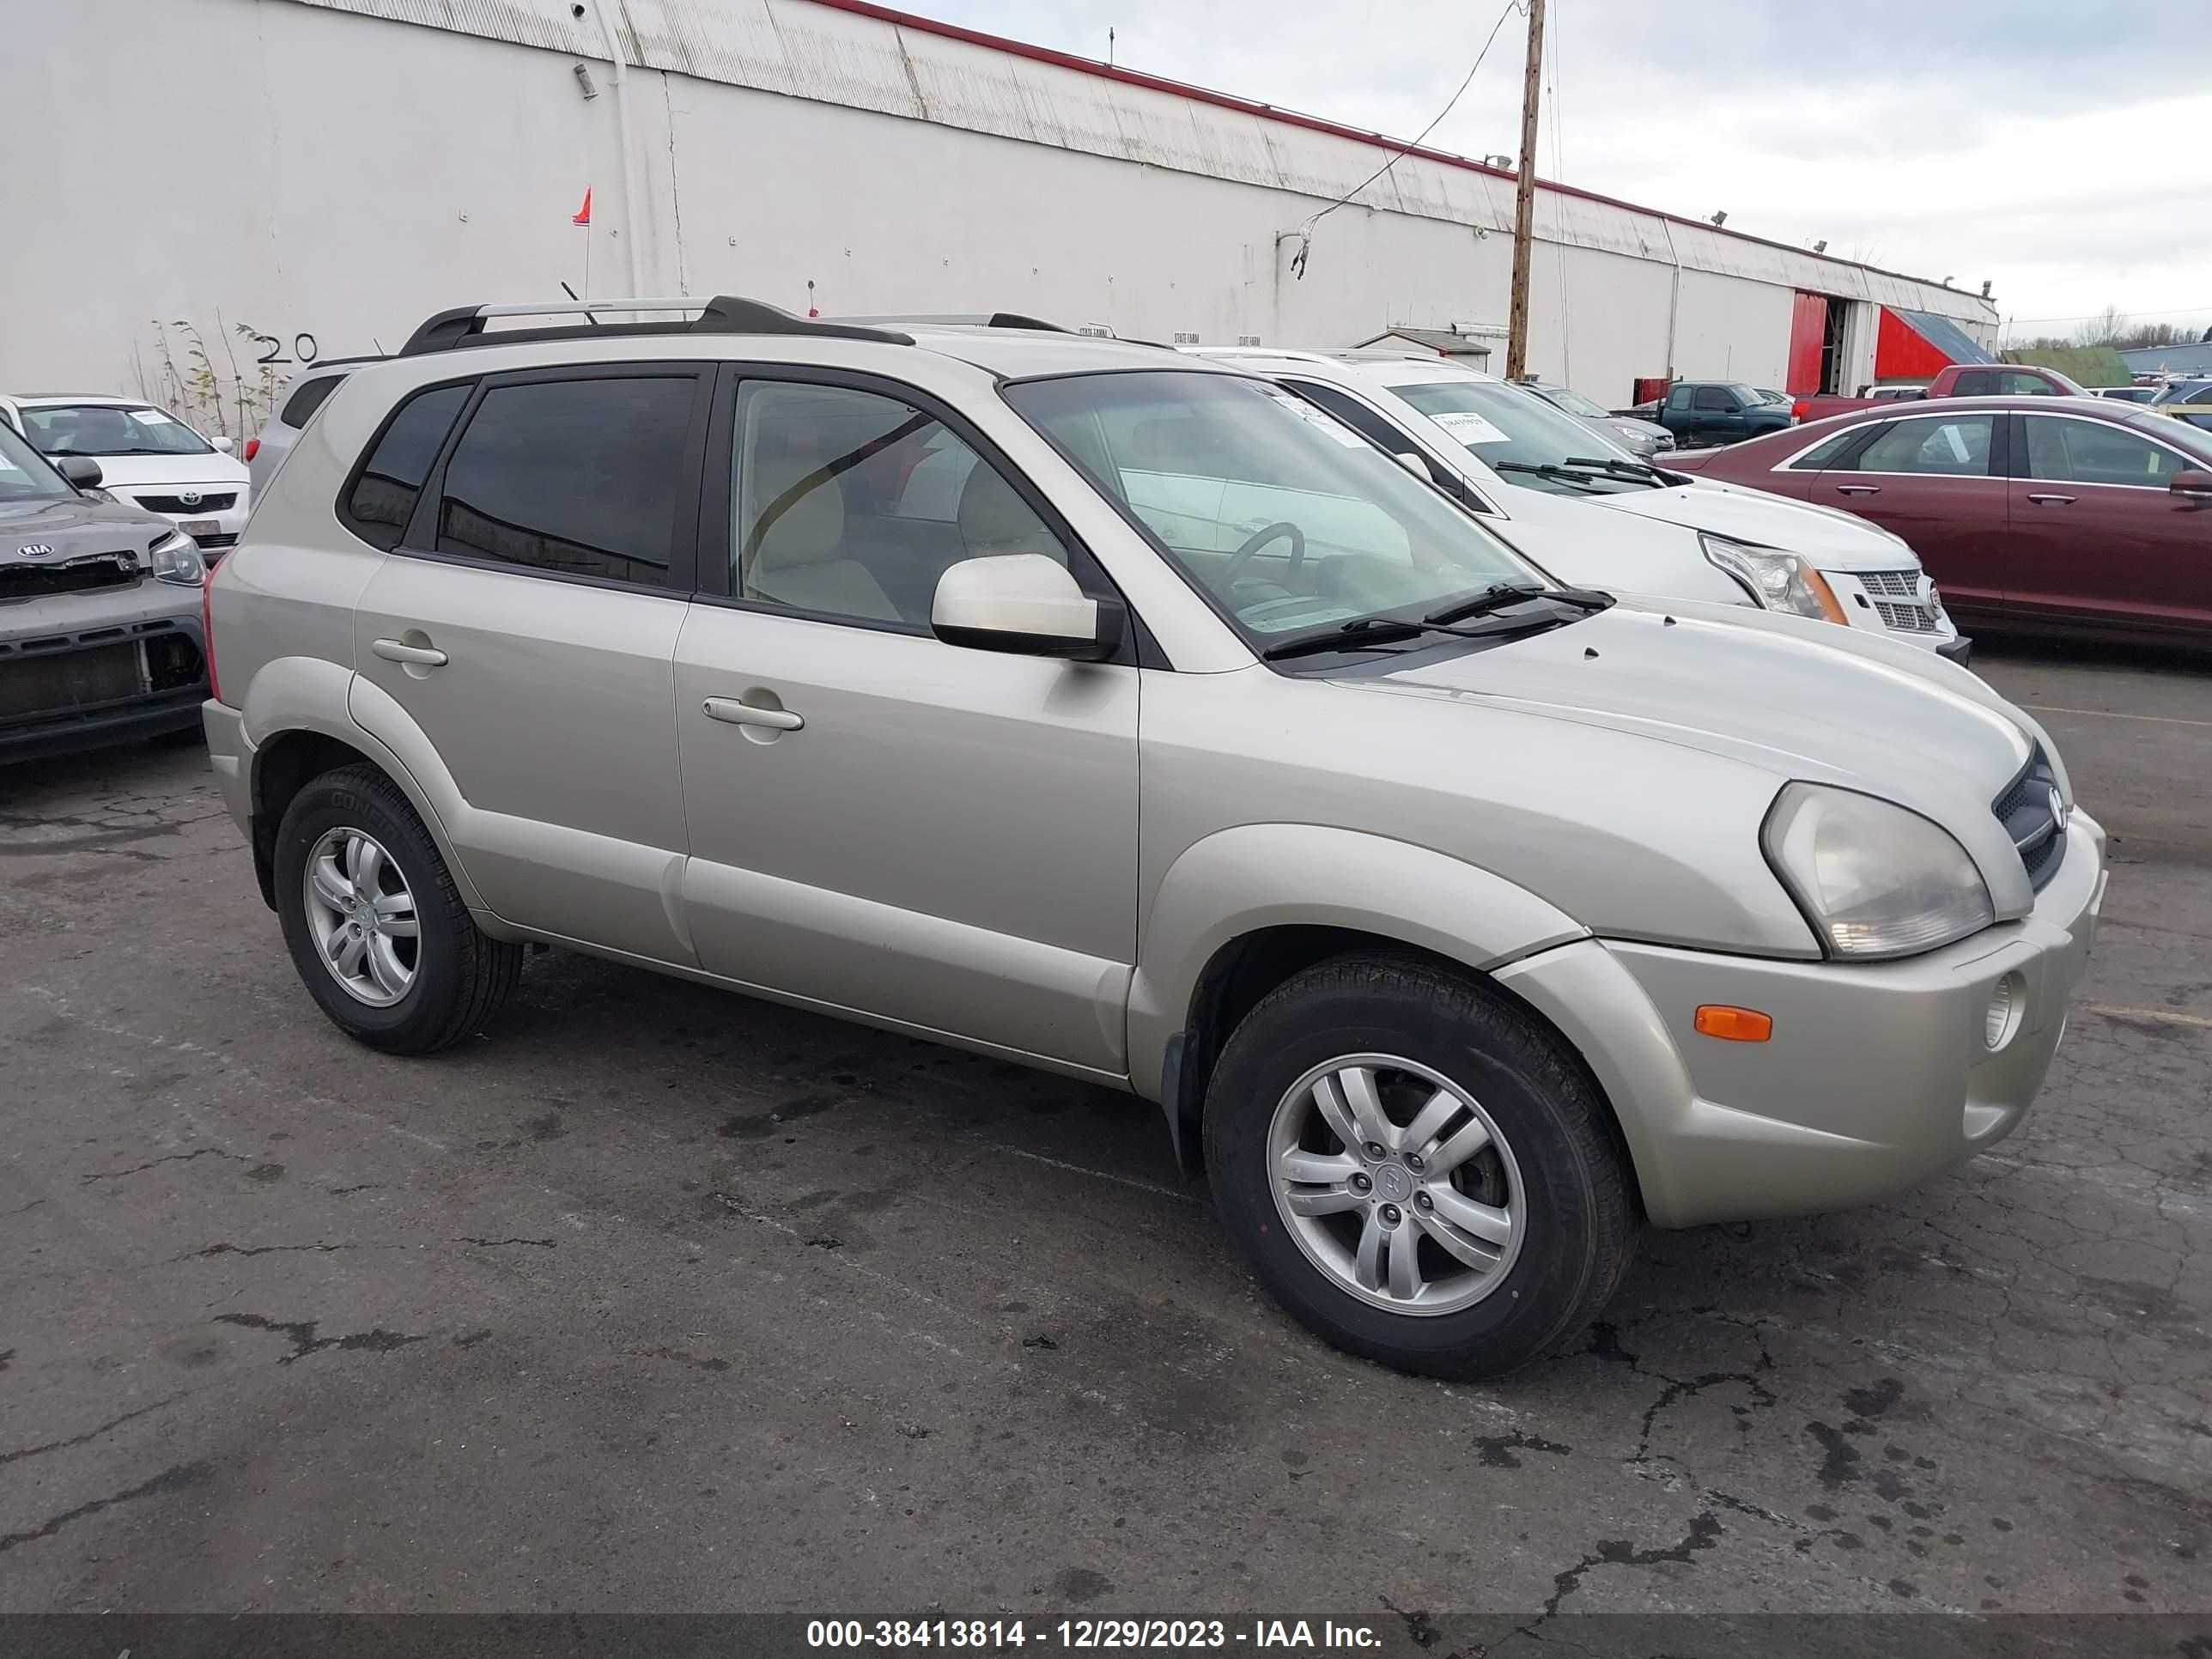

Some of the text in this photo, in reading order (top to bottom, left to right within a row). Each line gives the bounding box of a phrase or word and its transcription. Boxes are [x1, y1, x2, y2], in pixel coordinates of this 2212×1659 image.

[1174, 332, 1200, 343] STATE FARM
[21, 544, 51, 555] KIA
